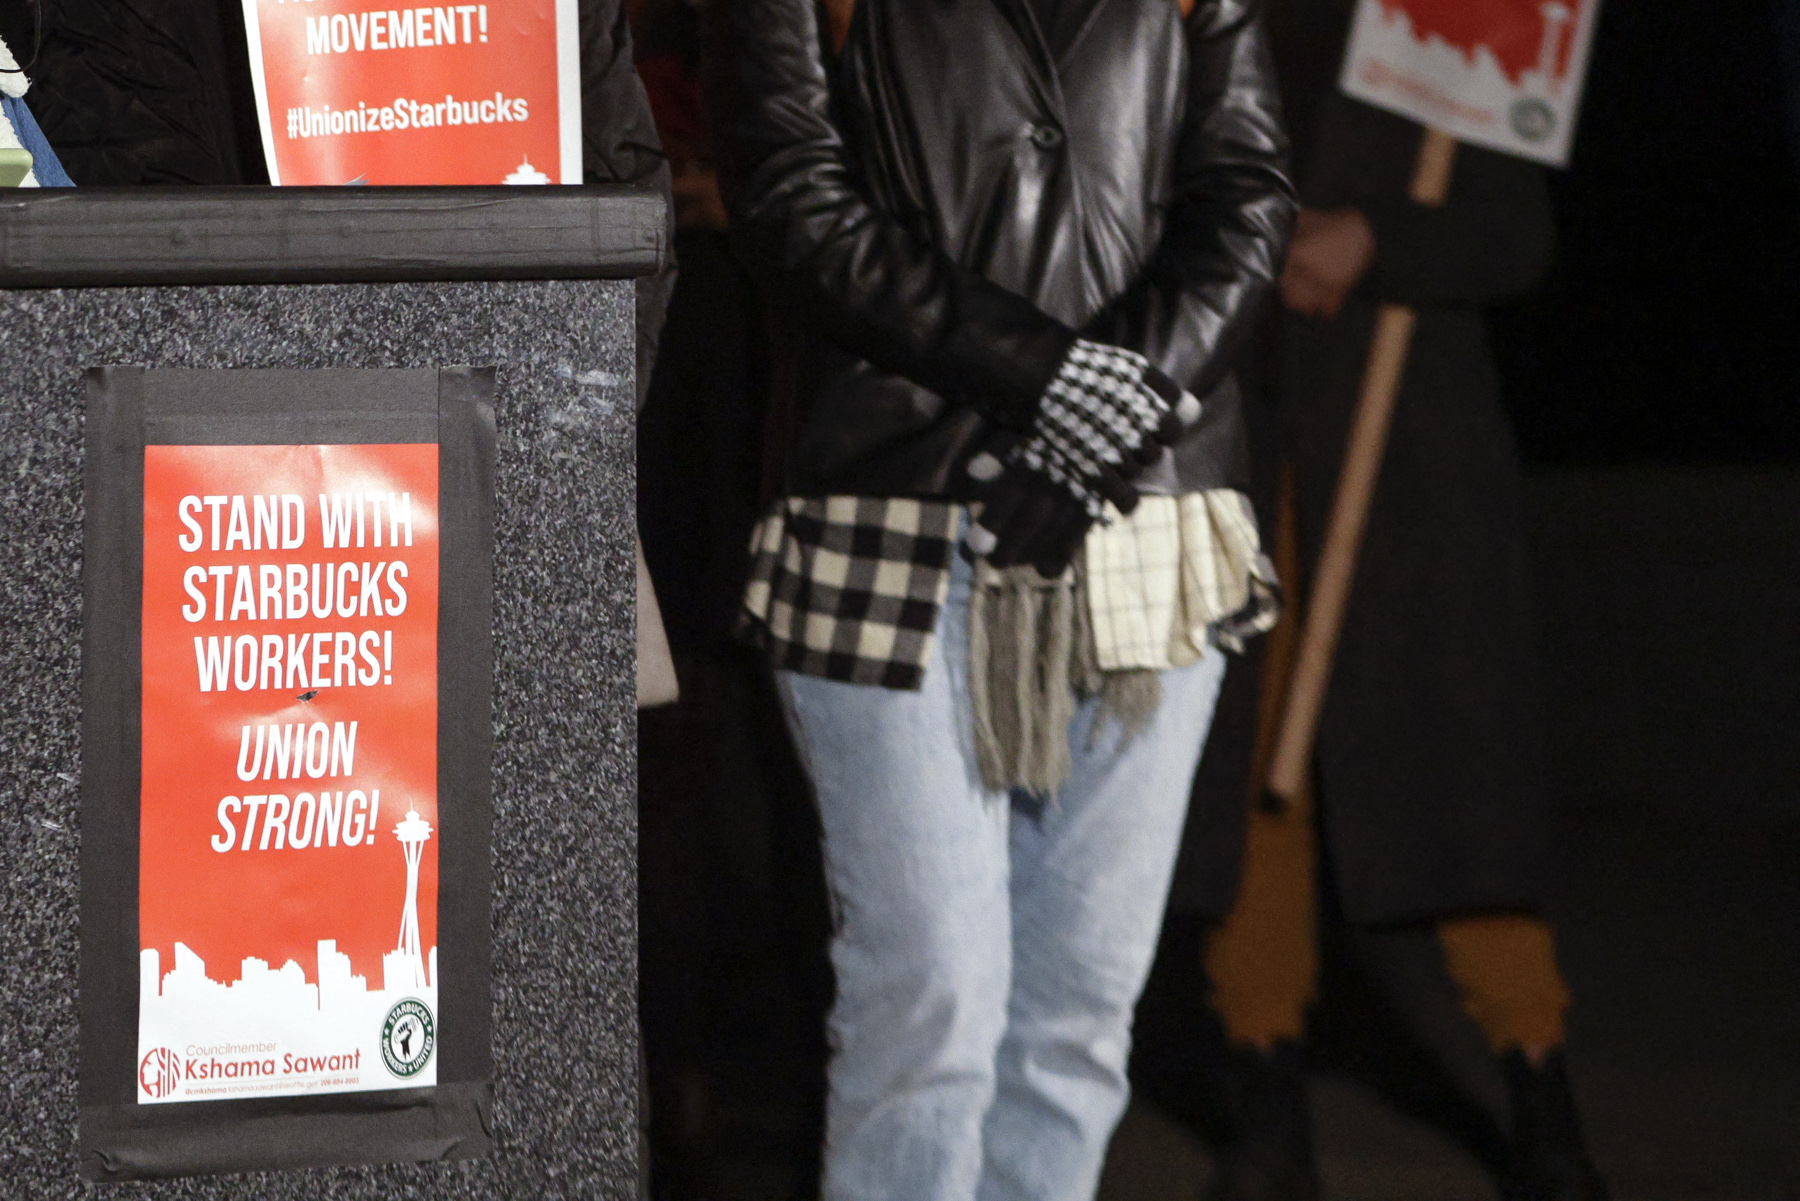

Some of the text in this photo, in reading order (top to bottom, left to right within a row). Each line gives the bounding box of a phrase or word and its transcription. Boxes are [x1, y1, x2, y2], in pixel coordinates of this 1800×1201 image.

[305, 4, 489, 56] MOVEMENT!
[286, 91, 529, 140] #UnionizeStarbucks
[177, 491, 414, 553] STAND WITH
[180, 559, 408, 624] STARBUCKS
[193, 629, 394, 693] WORKERS!
[235, 720, 359, 783] UNION
[210, 789, 380, 854] STRONG!
[388, 1001, 431, 1026] STARBUCKS
[185, 1042, 277, 1057] Councilmember
[185, 1047, 361, 1080] Kshama Sawant
[412, 1034, 434, 1071] UNITED
